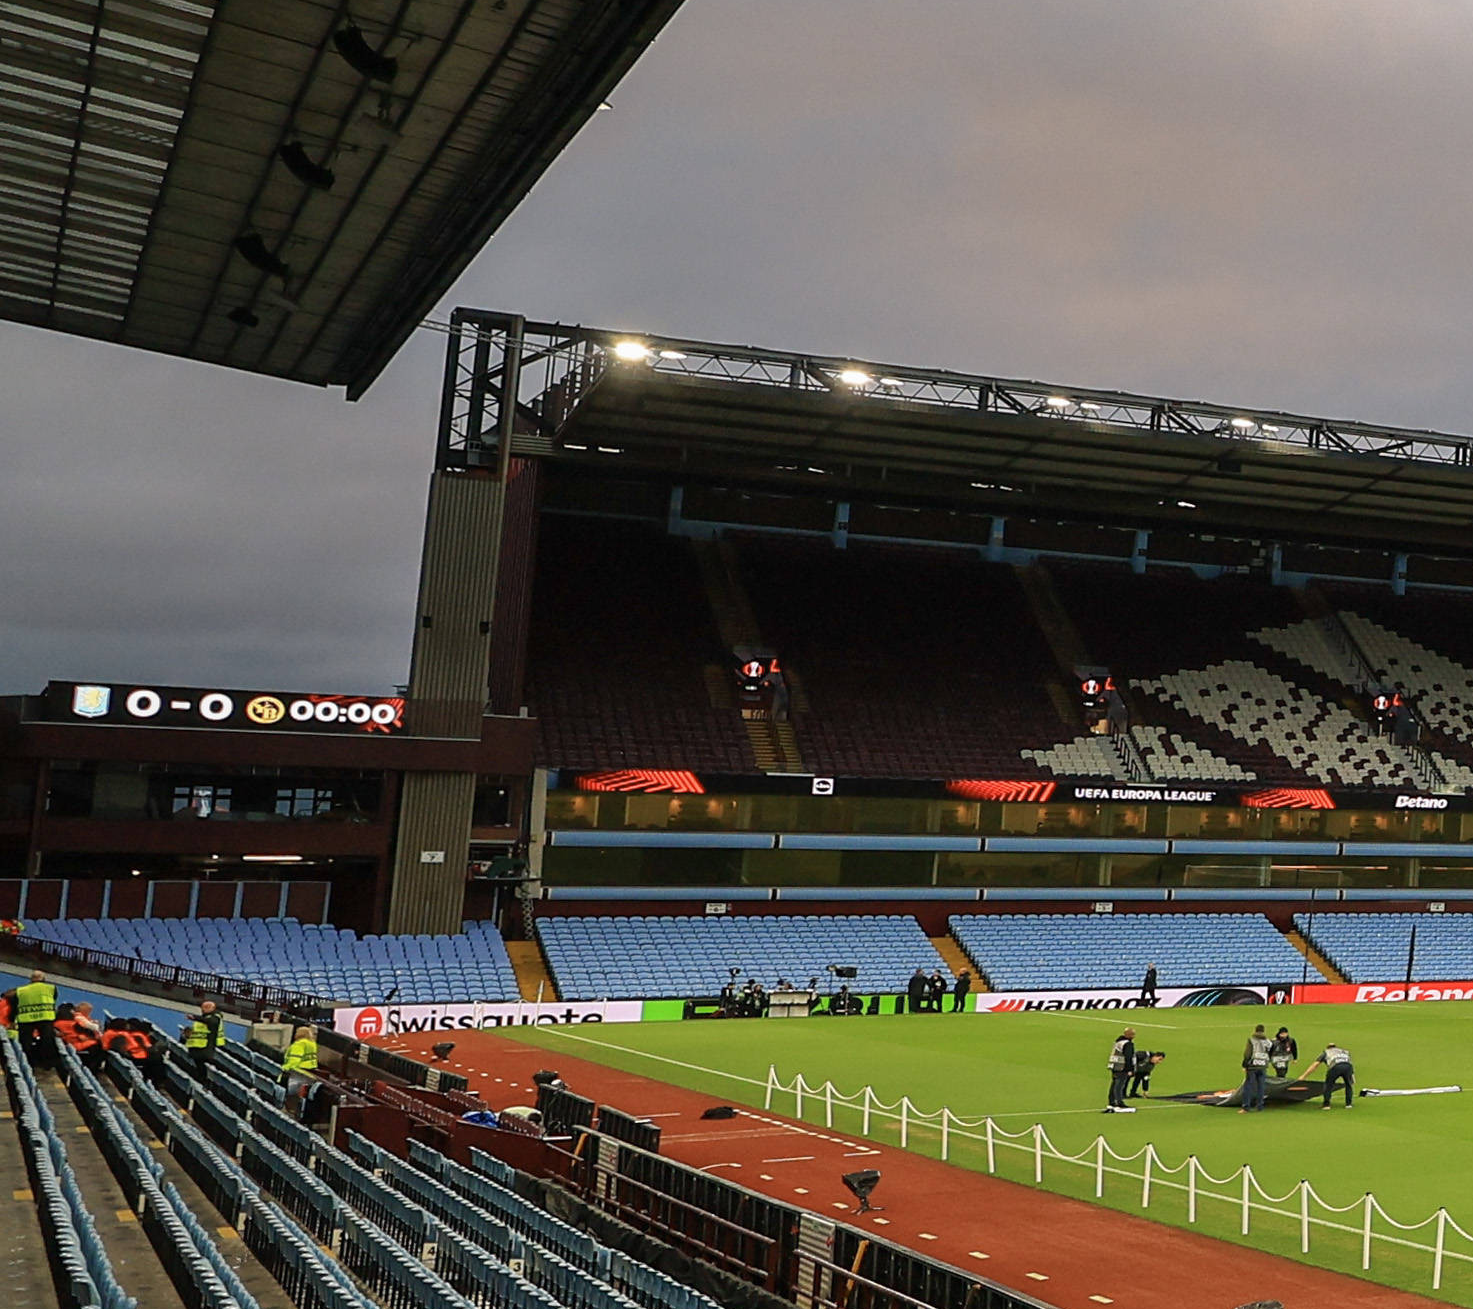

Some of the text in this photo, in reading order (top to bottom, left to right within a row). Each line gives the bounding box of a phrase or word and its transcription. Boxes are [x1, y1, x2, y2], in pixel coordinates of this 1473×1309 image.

[126, 690, 161, 718] 0
[199, 692, 234, 721] 0
[290, 700, 396, 725] 00:00
[1075, 788, 1213, 802] UEFA EUROPA LEAGUE
[1396, 795, 1448, 809] Betano
[513, 1261, 521, 1272] 3
